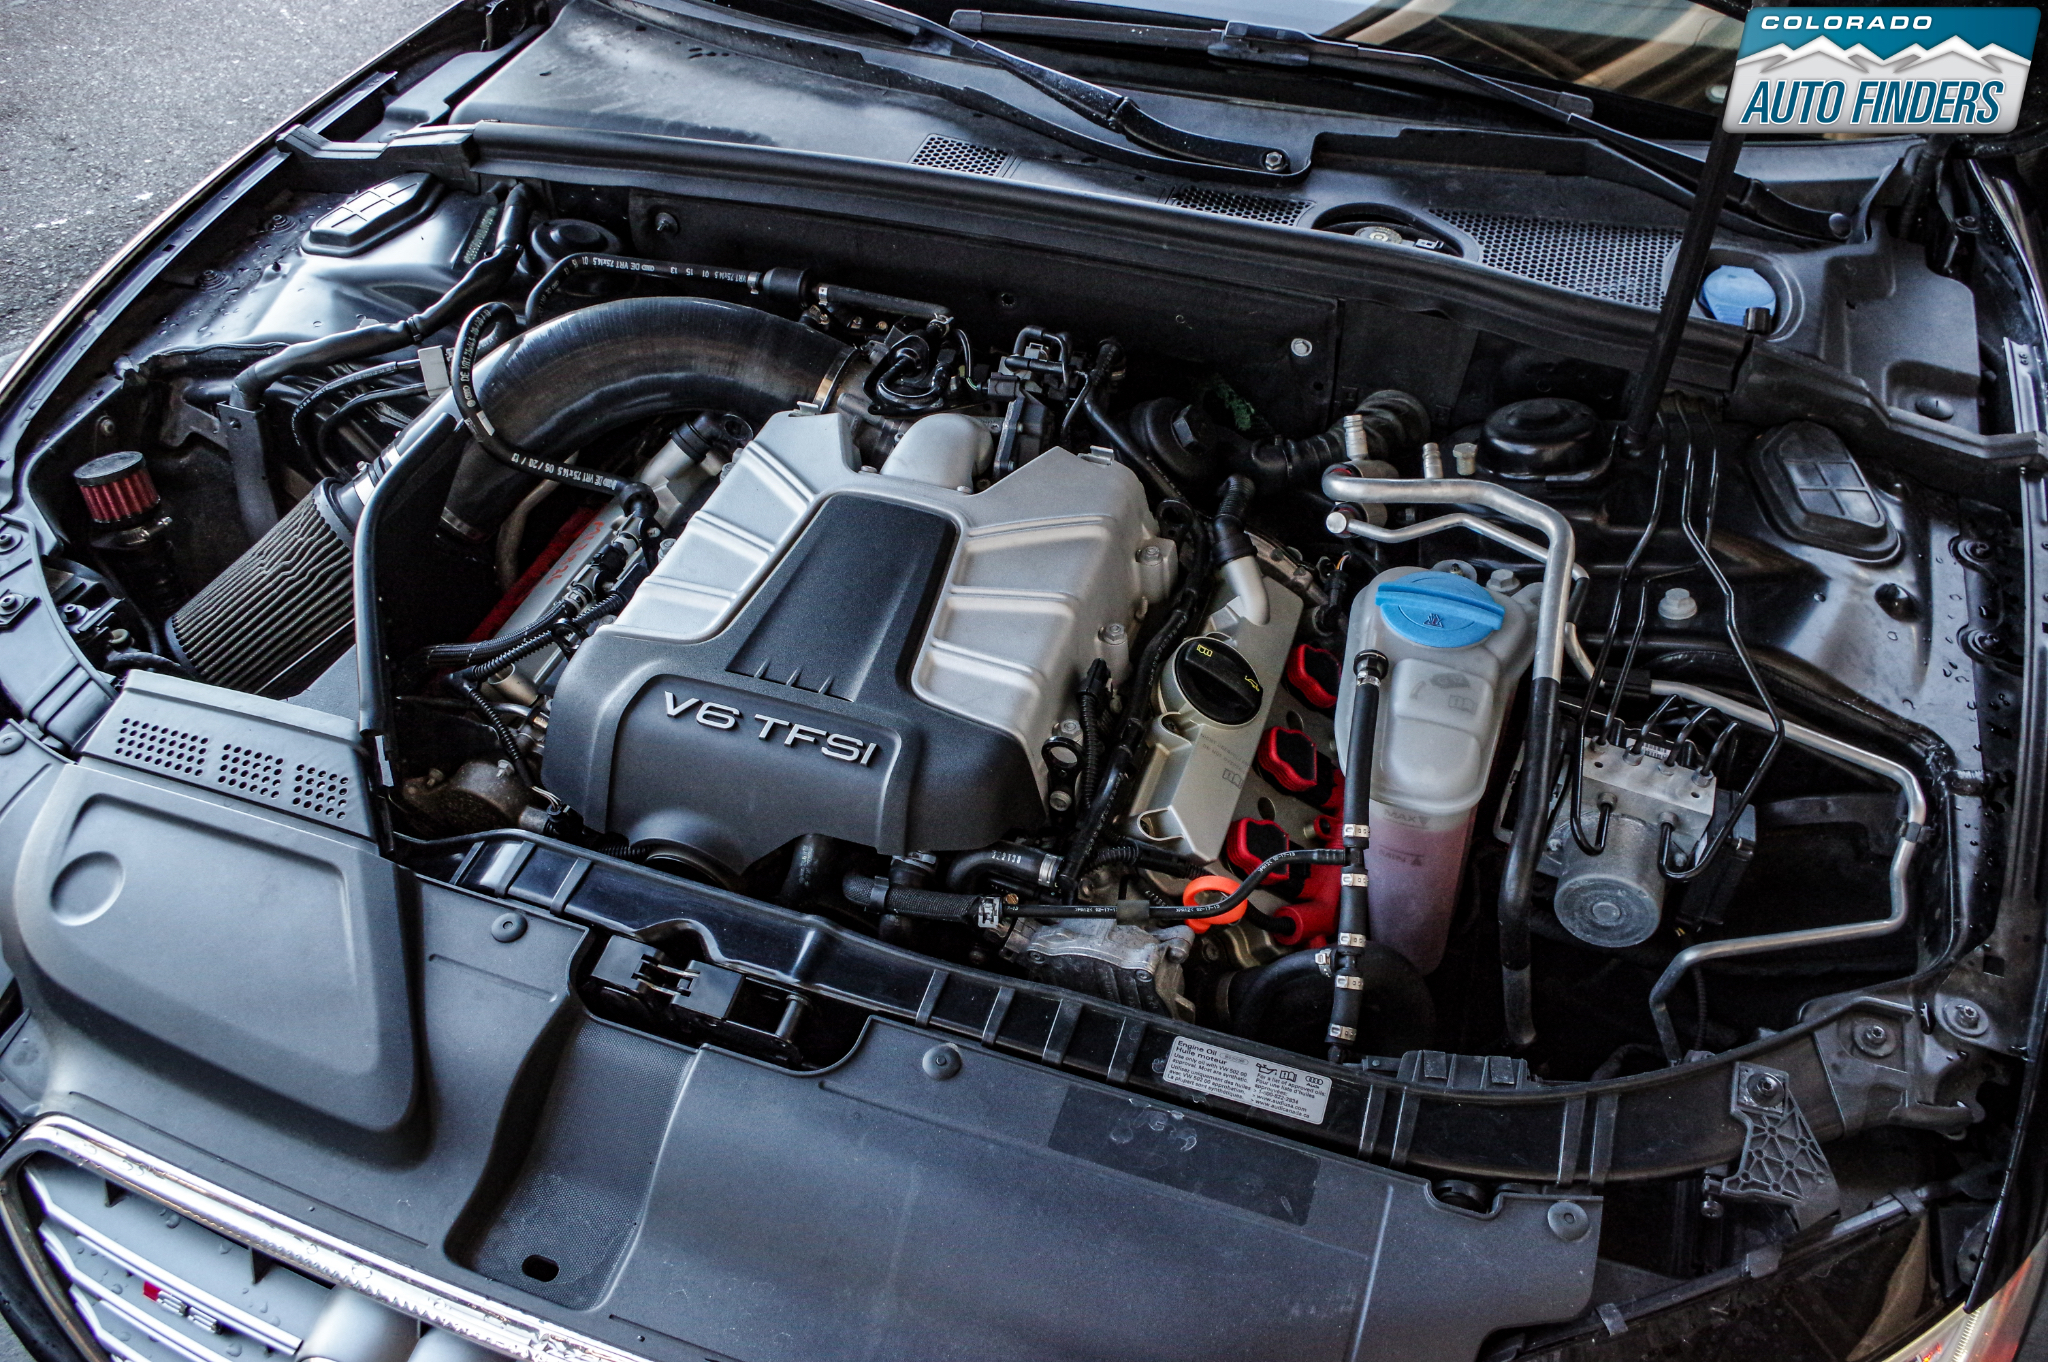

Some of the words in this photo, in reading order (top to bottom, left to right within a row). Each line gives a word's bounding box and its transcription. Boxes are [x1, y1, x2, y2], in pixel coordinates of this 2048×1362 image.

[615, 260, 628, 269] VRT
[665, 690, 742, 729] V6
[754, 713, 878, 767] TFSI
[1384, 808, 1416, 822] MAX
[1176, 1040, 1204, 1054] Engine
[1175, 1046, 1195, 1056] Huile
[1197, 1053, 1227, 1065] moteur
[1184, 1055, 1197, 1064] only
[1170, 1064, 1189, 1073] Utilisez
[1190, 1070, 1222, 1084] uniquement
[1234, 1082, 1251, 1090] huiles
[1287, 1082, 1313, 1093] approved
